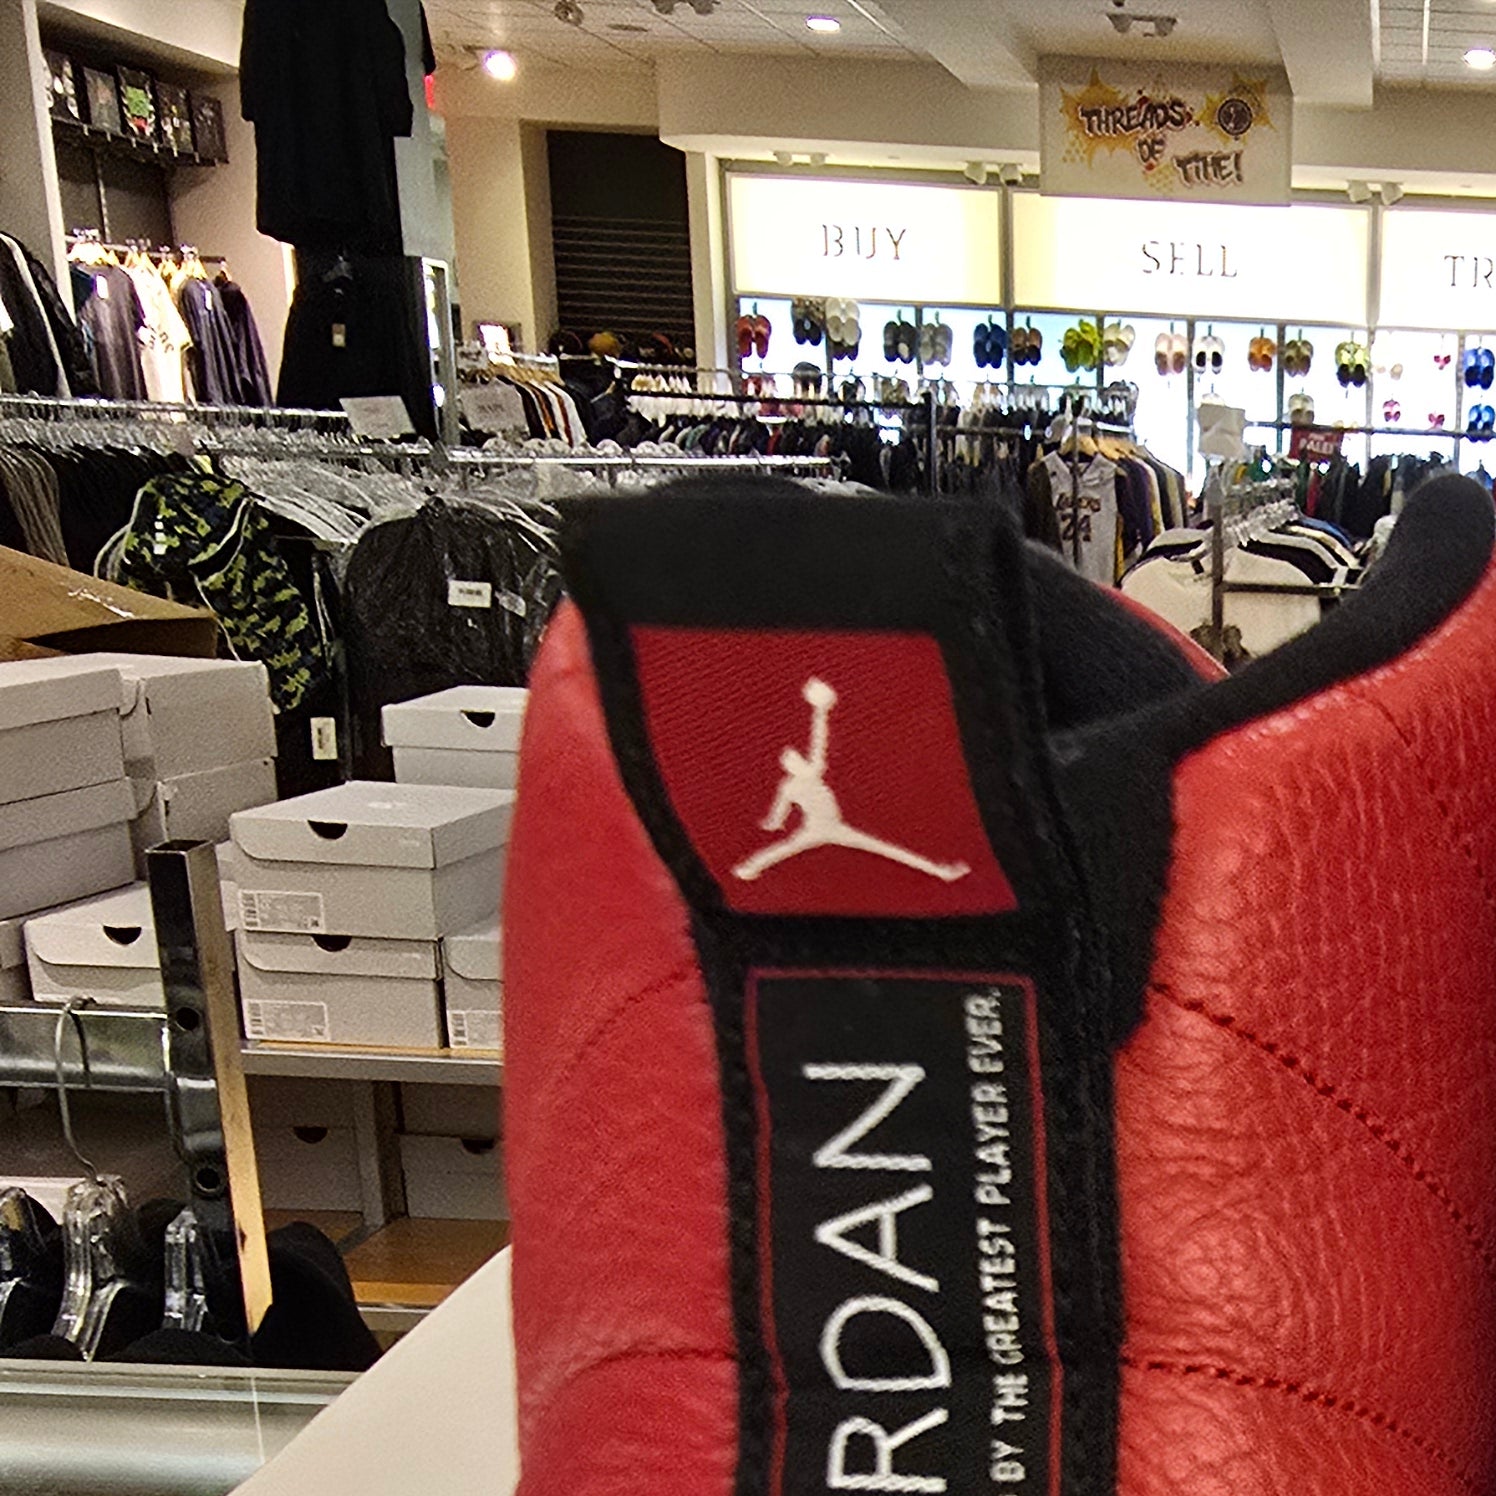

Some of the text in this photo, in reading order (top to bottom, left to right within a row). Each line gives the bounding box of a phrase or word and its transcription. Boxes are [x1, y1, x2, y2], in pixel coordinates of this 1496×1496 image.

[1078, 96, 1188, 137] THREADS
[1136, 137, 1165, 163] OF
[822, 224, 906, 260] BUY
[1142, 240, 1237, 278] SELL
[971, 1083, 1012, 1205] PLAYER
[976, 1218, 1025, 1365] GREATEST
[991, 1373, 1029, 1426] THE
[990, 1440, 1026, 1482] BY
